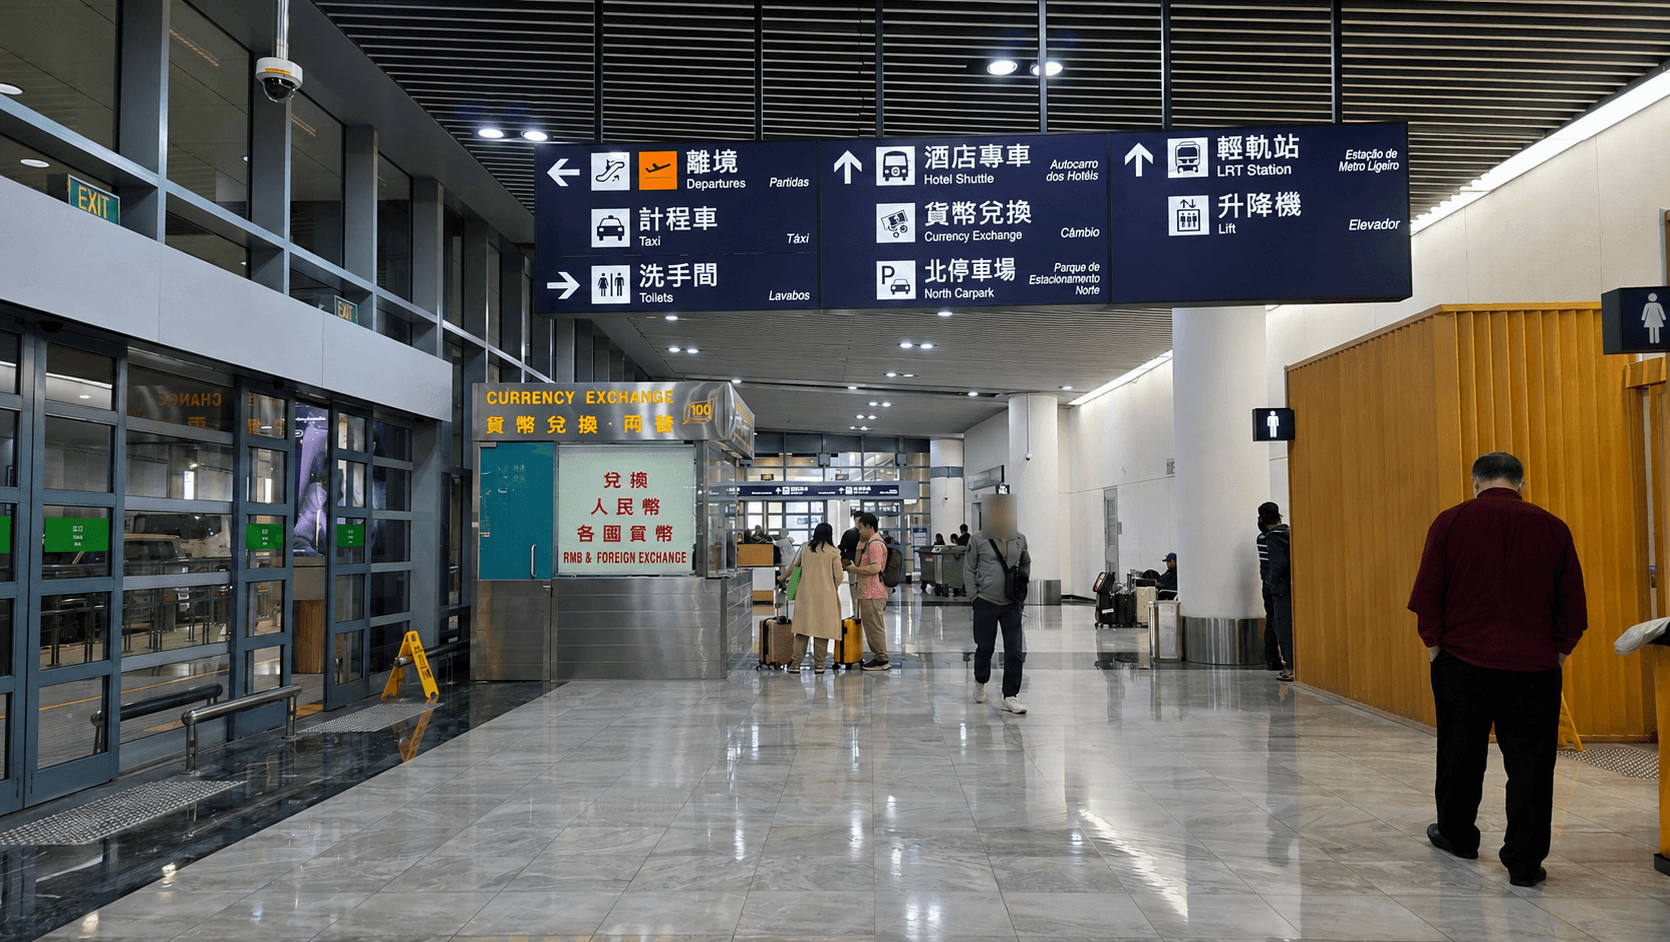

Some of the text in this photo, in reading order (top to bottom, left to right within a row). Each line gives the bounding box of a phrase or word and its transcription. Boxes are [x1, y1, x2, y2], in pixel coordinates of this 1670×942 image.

[1217, 134, 1299, 160] 輕軌站
[925, 143, 1030, 169] 酒店專車
[1386, 149, 1397, 161] de
[686, 149, 737, 174] 離境
[1050, 159, 1098, 170] Autocarro
[1339, 161, 1365, 171] Metro
[1046, 171, 1064, 181] dos
[1218, 164, 1291, 176] LRT Station
[687, 178, 746, 190] Departures
[770, 177, 809, 187] Partidas
[925, 173, 994, 184] Hotel Shuttle
[78, 184, 110, 219] EXIT
[1218, 192, 1301, 218] 升降機
[639, 206, 717, 231] 計程車
[925, 200, 1031, 226] 貨幣兌換
[1219, 223, 1236, 234] Lift
[1349, 218, 1400, 230] Elevador
[639, 236, 660, 246] Taxi
[787, 233, 809, 243] Táxi
[925, 230, 1022, 243] Currency Exchange
[925, 258, 1015, 283] 北停車場
[1054, 262, 1100, 274] Parque de
[640, 263, 717, 287] 洗手間
[1029, 274, 1100, 285] Estacionamento
[769, 290, 810, 300] Lavabos
[925, 287, 994, 300] North Carpark
[1076, 285, 1100, 295] Norte
[337, 301, 353, 321] EXIT
[487, 391, 673, 404] CURRENCY EXCHANGE
[690, 403, 711, 416] 100
[591, 498, 659, 515] 人民幣
[564, 552, 685, 563] RMB & FOREIGN EXCHANGE
